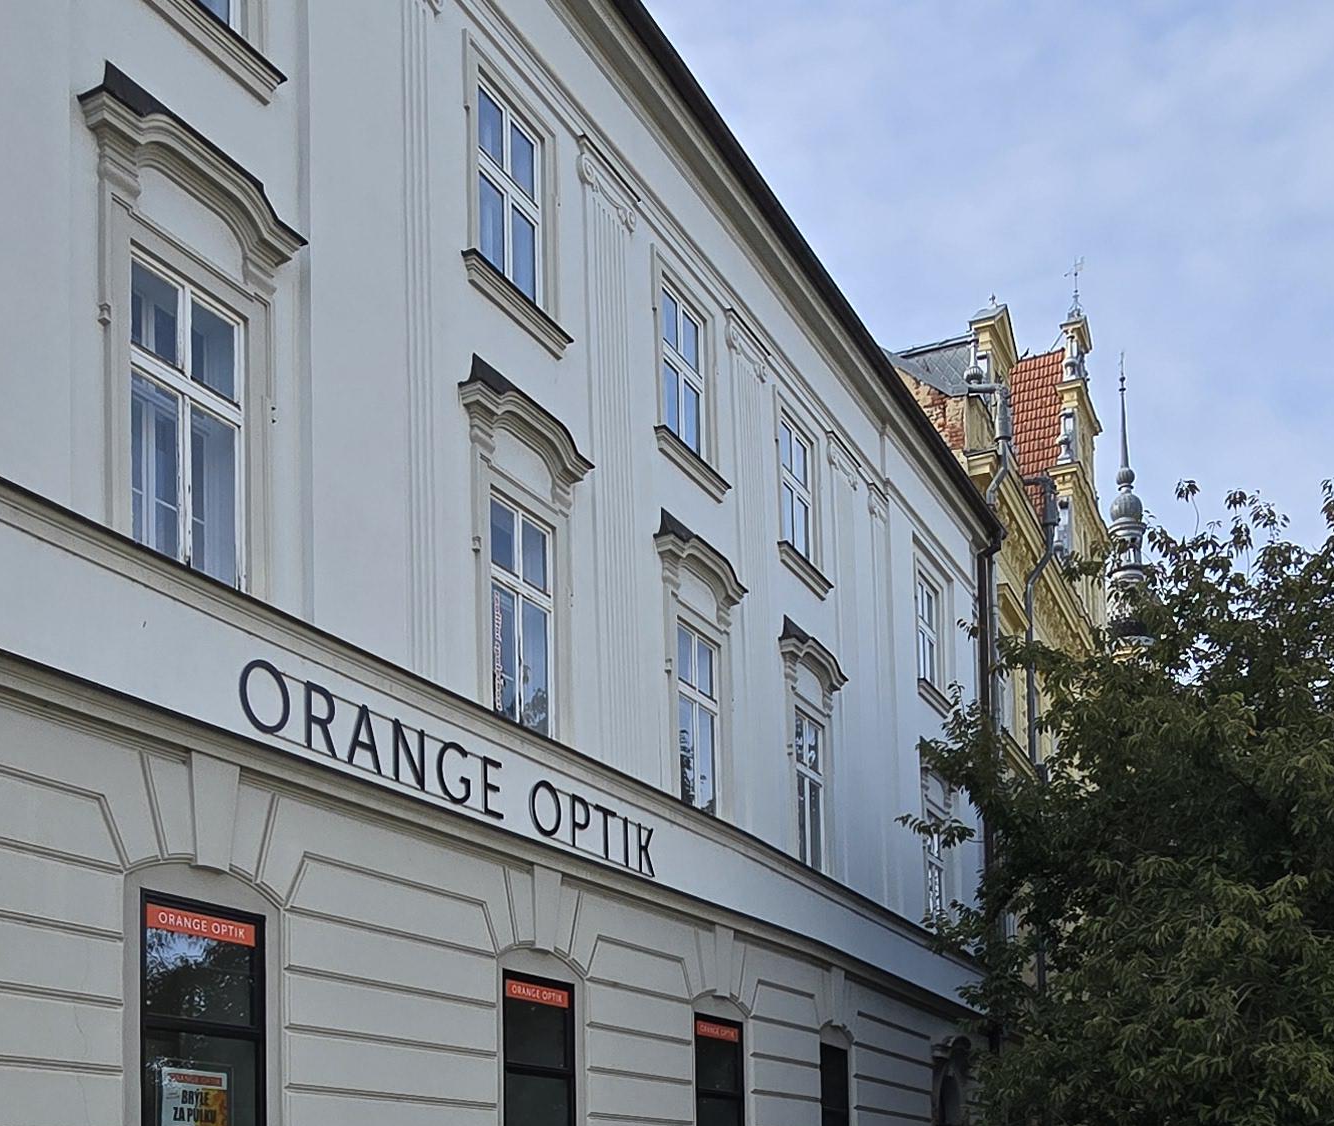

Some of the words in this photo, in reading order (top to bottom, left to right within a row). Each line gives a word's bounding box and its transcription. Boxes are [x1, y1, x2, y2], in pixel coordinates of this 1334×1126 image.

[238, 658, 505, 821] ORANGE
[527, 779, 655, 879] OPTIK
[157, 911, 208, 933] ORANGE
[211, 922, 246, 939] OPTIK
[511, 984, 540, 1000] ORANGE
[542, 990, 564, 1003] OPTIK
[181, 1088, 209, 1106] BRÝLE
[172, 1106, 185, 1121] ZA
